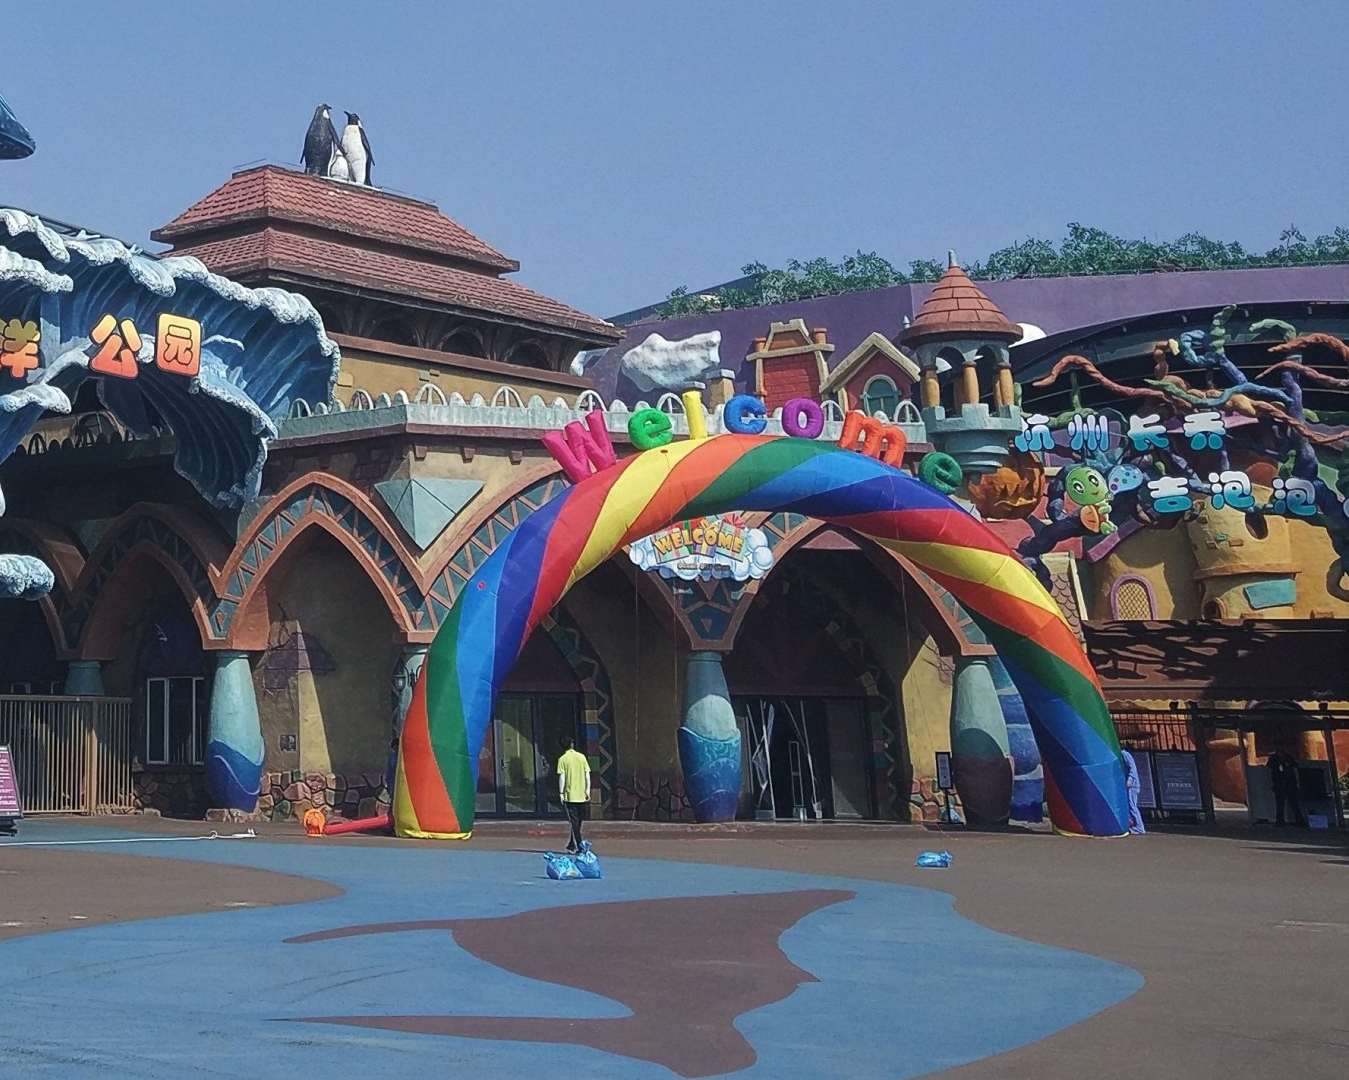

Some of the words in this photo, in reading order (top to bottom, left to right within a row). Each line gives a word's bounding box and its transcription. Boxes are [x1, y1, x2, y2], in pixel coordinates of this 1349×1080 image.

[1014, 411, 1227, 453] 杭州长乔
[1147, 470, 1349, 517] 吉泡泡
[653, 527, 746, 555] WELCOME
